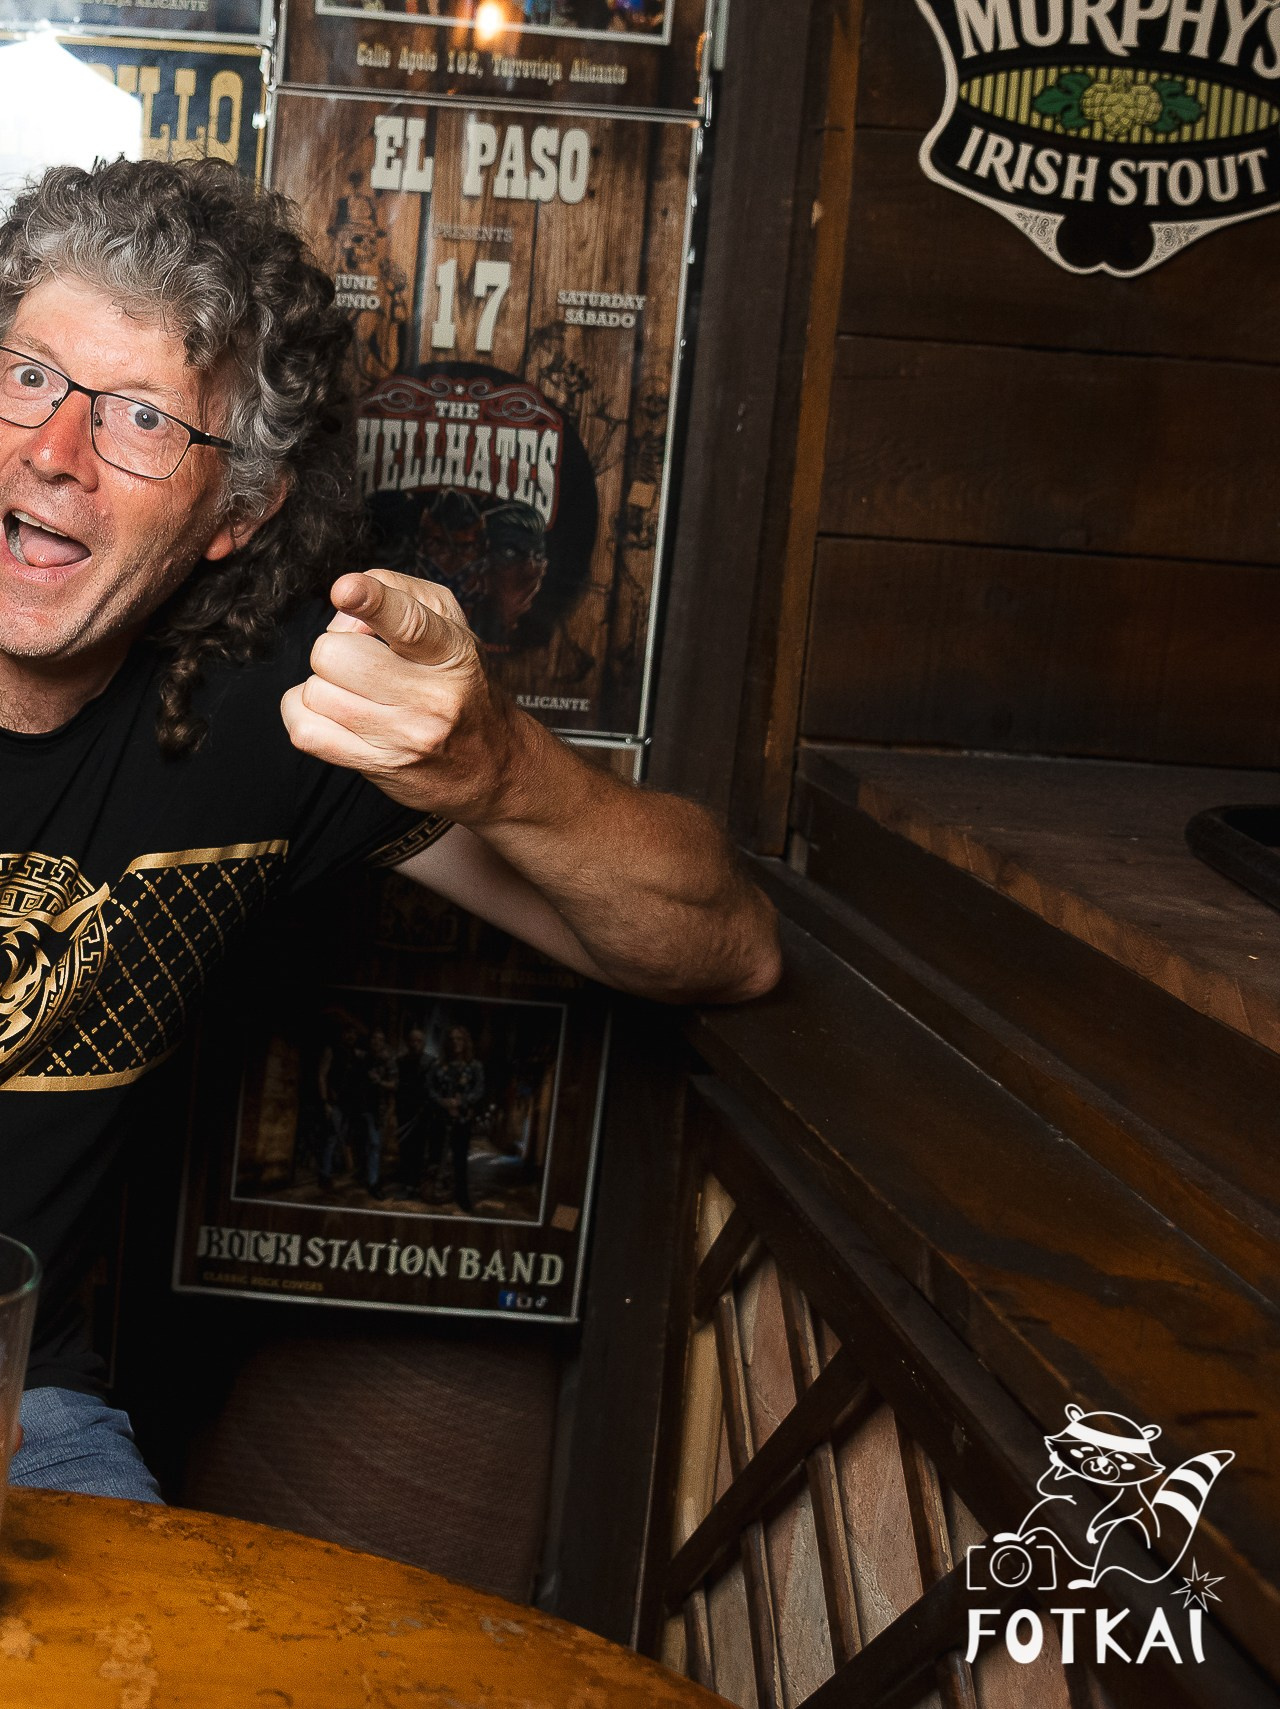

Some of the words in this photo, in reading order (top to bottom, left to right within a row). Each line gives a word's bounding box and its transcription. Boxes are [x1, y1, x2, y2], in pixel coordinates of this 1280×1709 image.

[356, 42, 392, 69] Calle
[491, 53, 562, 86] Torrevieja
[569, 57, 629, 85] Alicante
[370, 115, 434, 193] EL
[462, 122, 591, 204] PASO
[957, 127, 1099, 202] IRISH
[1108, 149, 1268, 206] STOUT
[336, 293, 381, 310] UNIO
[431, 258, 511, 351] 17
[558, 290, 646, 311] SATURDAY
[435, 401, 479, 420] THE
[357, 418, 559, 523] HELLHATES
[198, 1225, 300, 1267] ROCK
[458, 1248, 564, 1287] BAND
